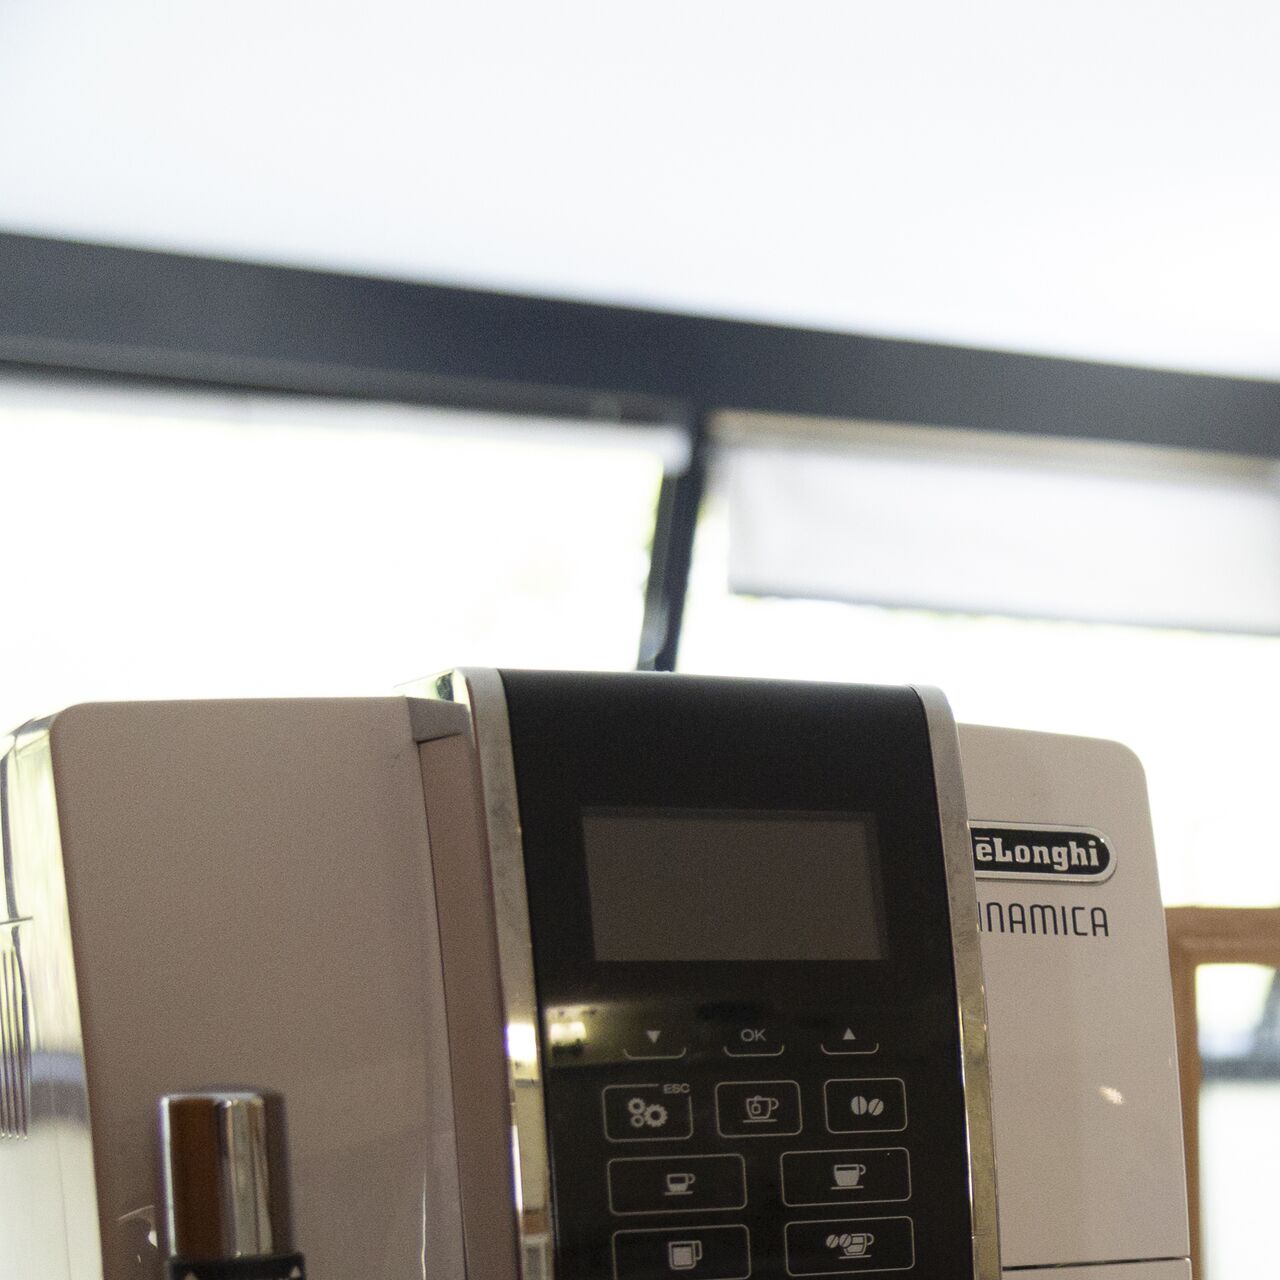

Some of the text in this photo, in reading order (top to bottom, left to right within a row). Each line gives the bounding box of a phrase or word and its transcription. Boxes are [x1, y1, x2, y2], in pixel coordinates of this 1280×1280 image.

[977, 901, 1109, 937] INAMICA
[740, 1028, 767, 1042] OK
[662, 1082, 691, 1094] ESC
